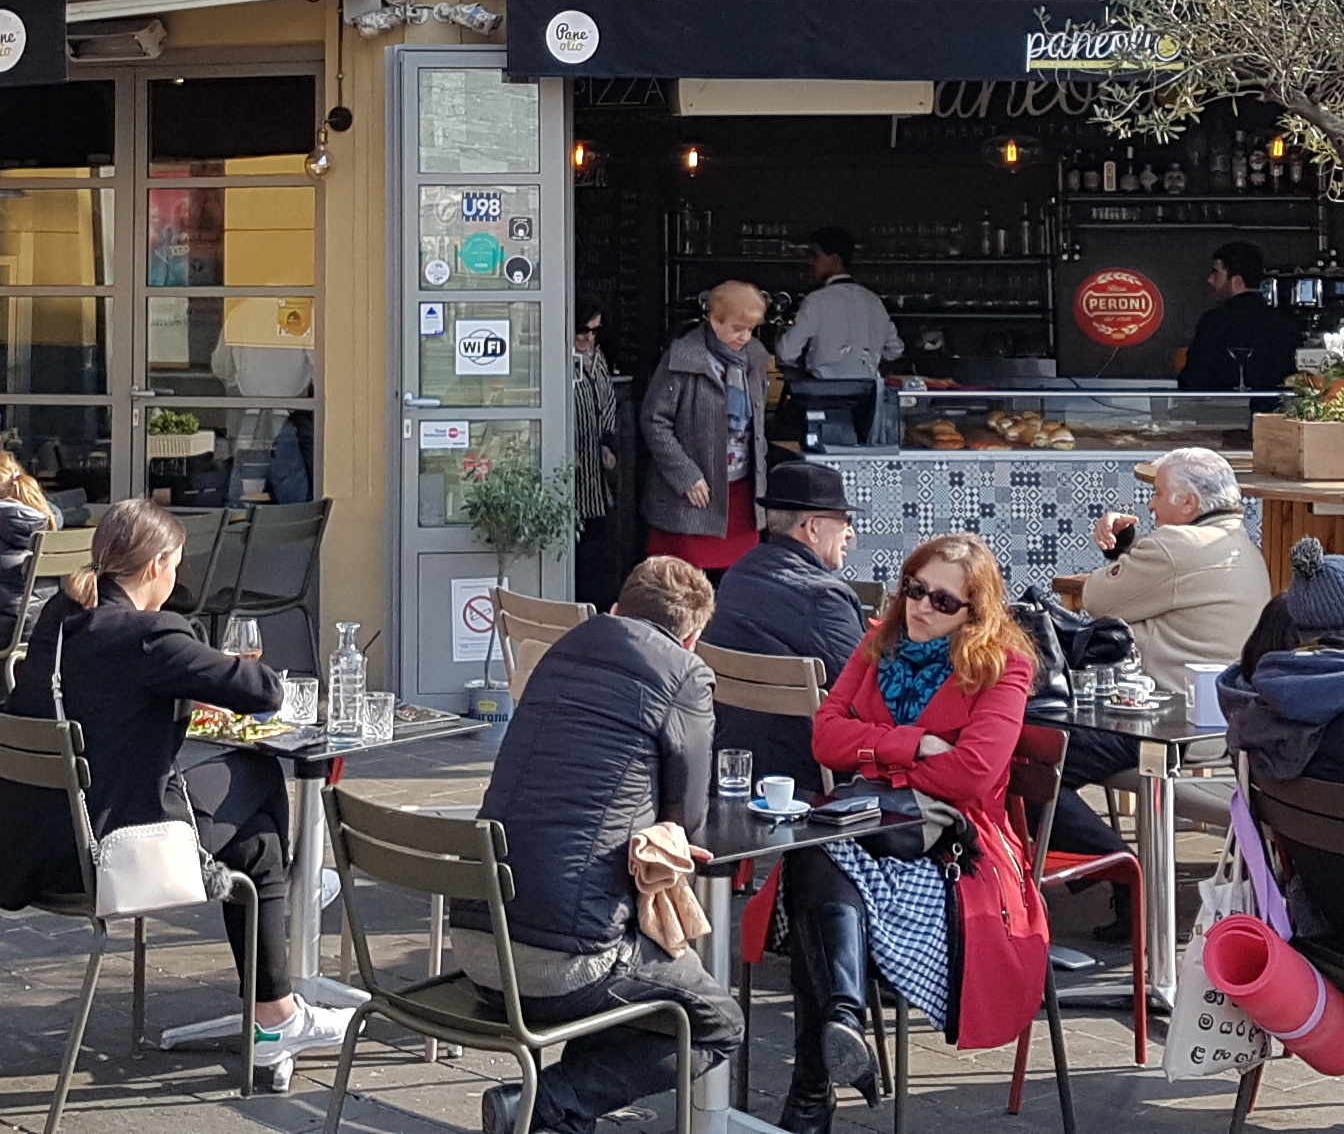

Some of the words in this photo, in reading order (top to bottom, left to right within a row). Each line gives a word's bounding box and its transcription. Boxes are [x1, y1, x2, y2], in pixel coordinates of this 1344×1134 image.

[555, 22, 589, 41] Pane
[462, 198, 502, 217] U98
[1089, 297, 1146, 310] PERONI
